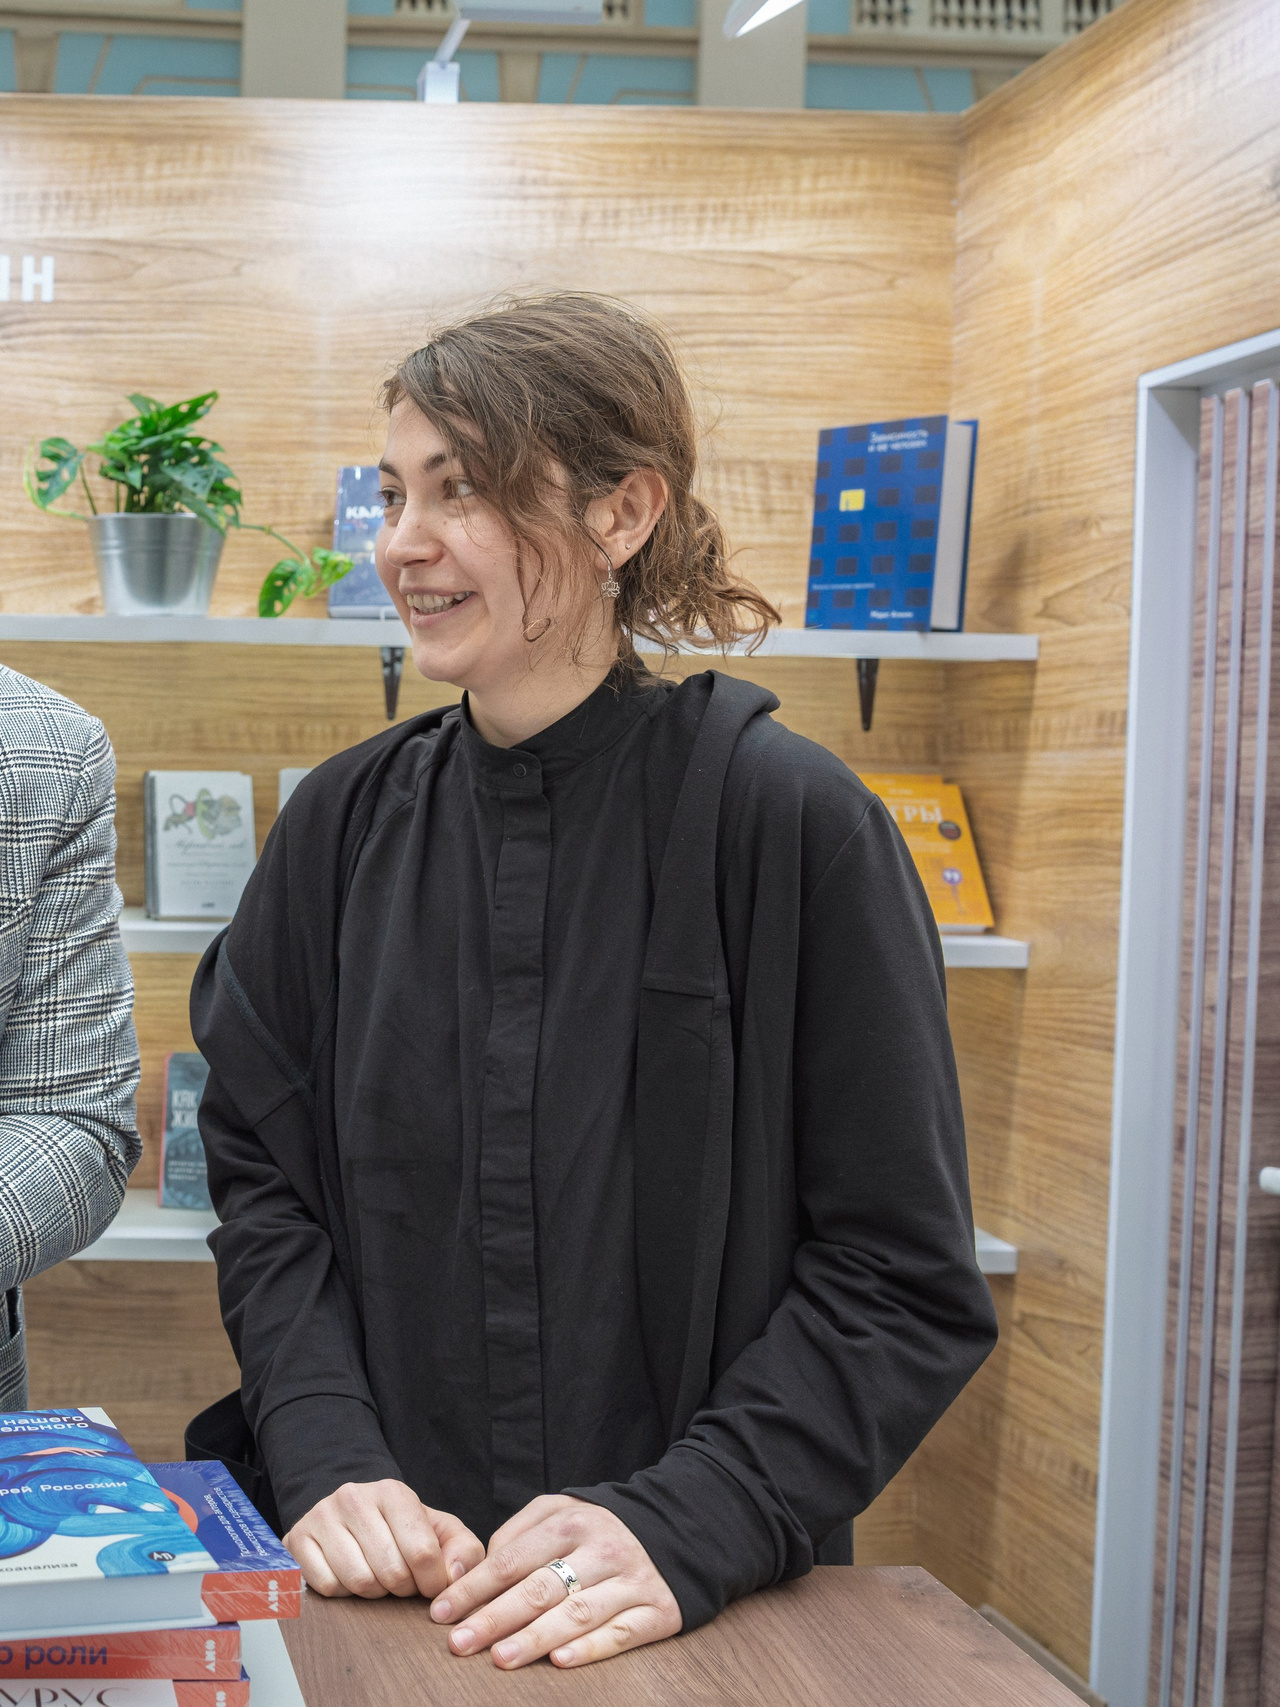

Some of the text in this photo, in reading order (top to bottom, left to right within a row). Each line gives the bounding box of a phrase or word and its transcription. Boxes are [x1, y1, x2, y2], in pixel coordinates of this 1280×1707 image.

[890, 804, 943, 823] ГРЫ
[4, 1415, 85, 1426] нашего
[40, 1481, 128, 1493] Россохин
[25, 1645, 108, 1670] роли
